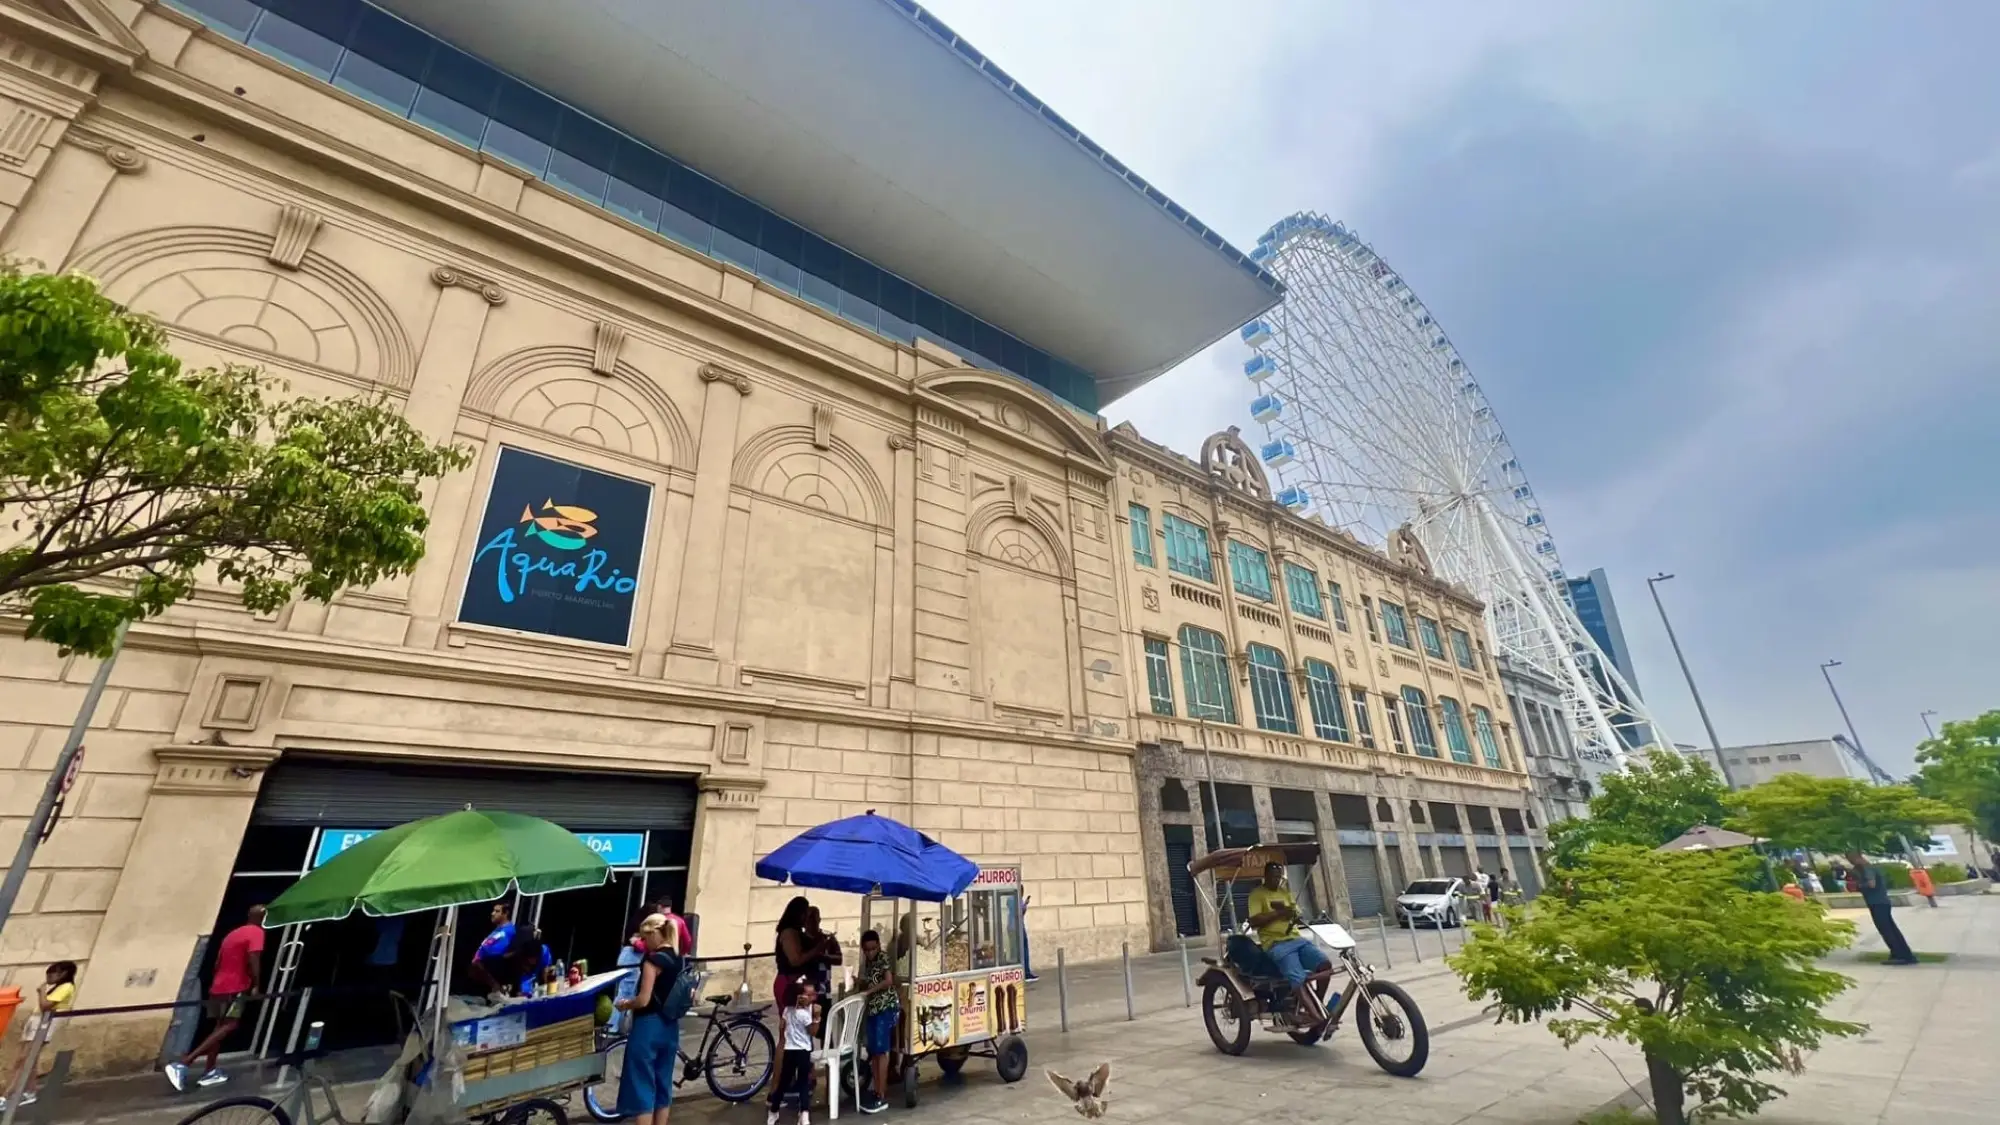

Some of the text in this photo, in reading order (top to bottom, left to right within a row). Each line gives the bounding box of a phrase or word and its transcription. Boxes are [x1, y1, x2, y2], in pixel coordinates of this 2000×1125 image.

[475, 528, 636, 603] AquaRio
[990, 970, 1023, 984] CHURROS
[917, 980, 954, 994] PIPOCA
